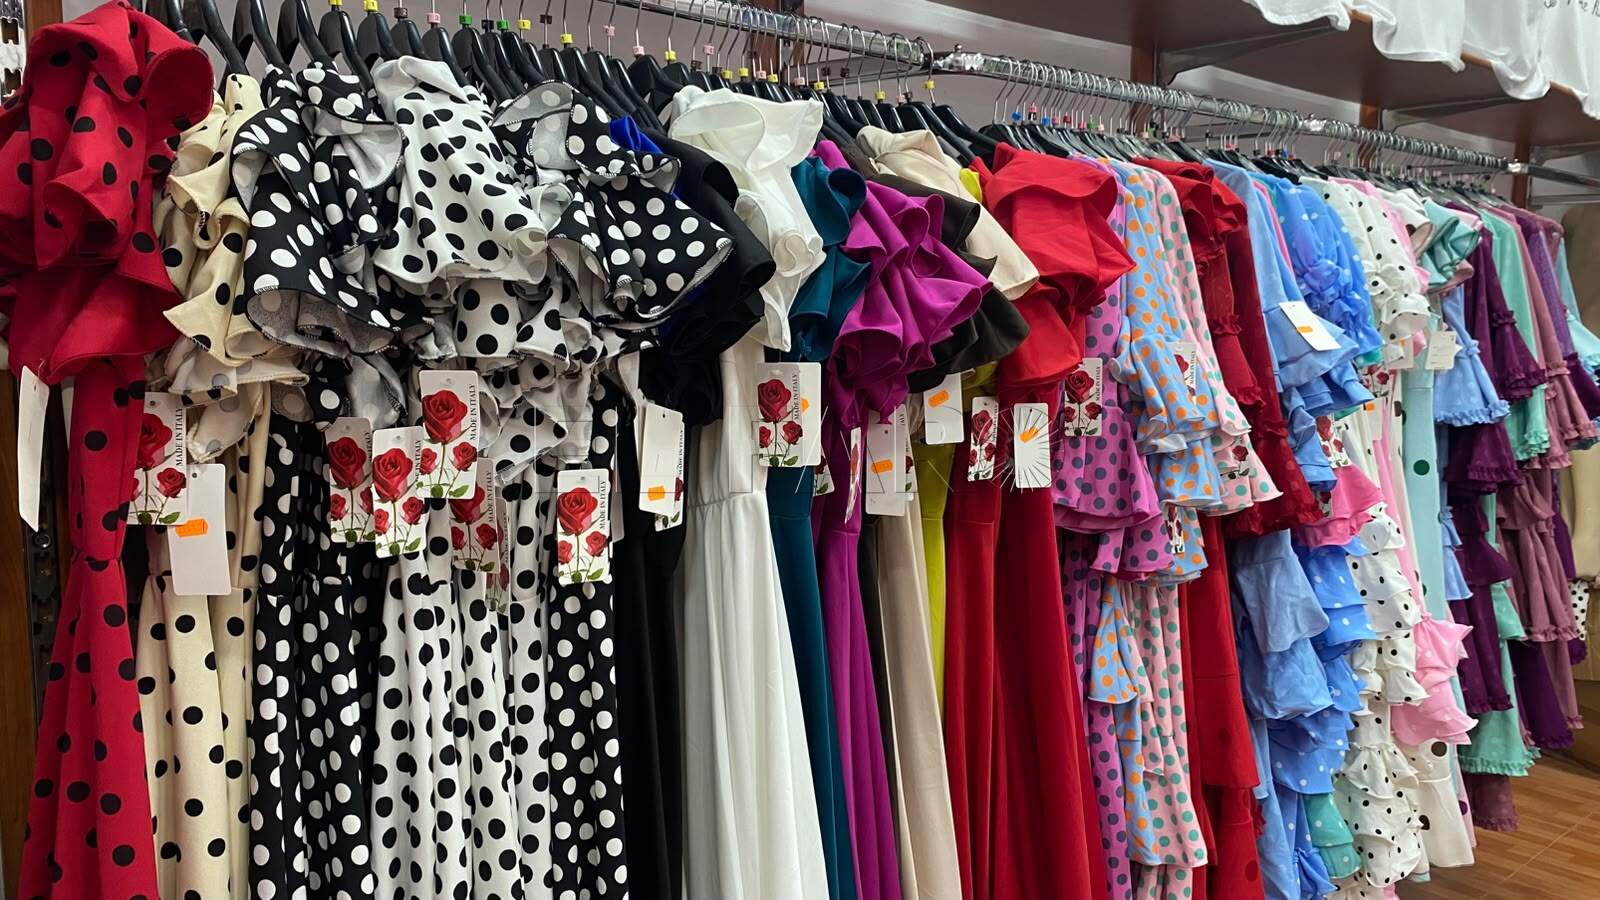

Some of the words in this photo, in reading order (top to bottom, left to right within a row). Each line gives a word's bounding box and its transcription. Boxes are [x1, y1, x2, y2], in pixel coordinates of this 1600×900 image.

[470, 408, 477, 416] IN
[176, 433, 183, 441] IN
[600, 501, 606, 509] IN
